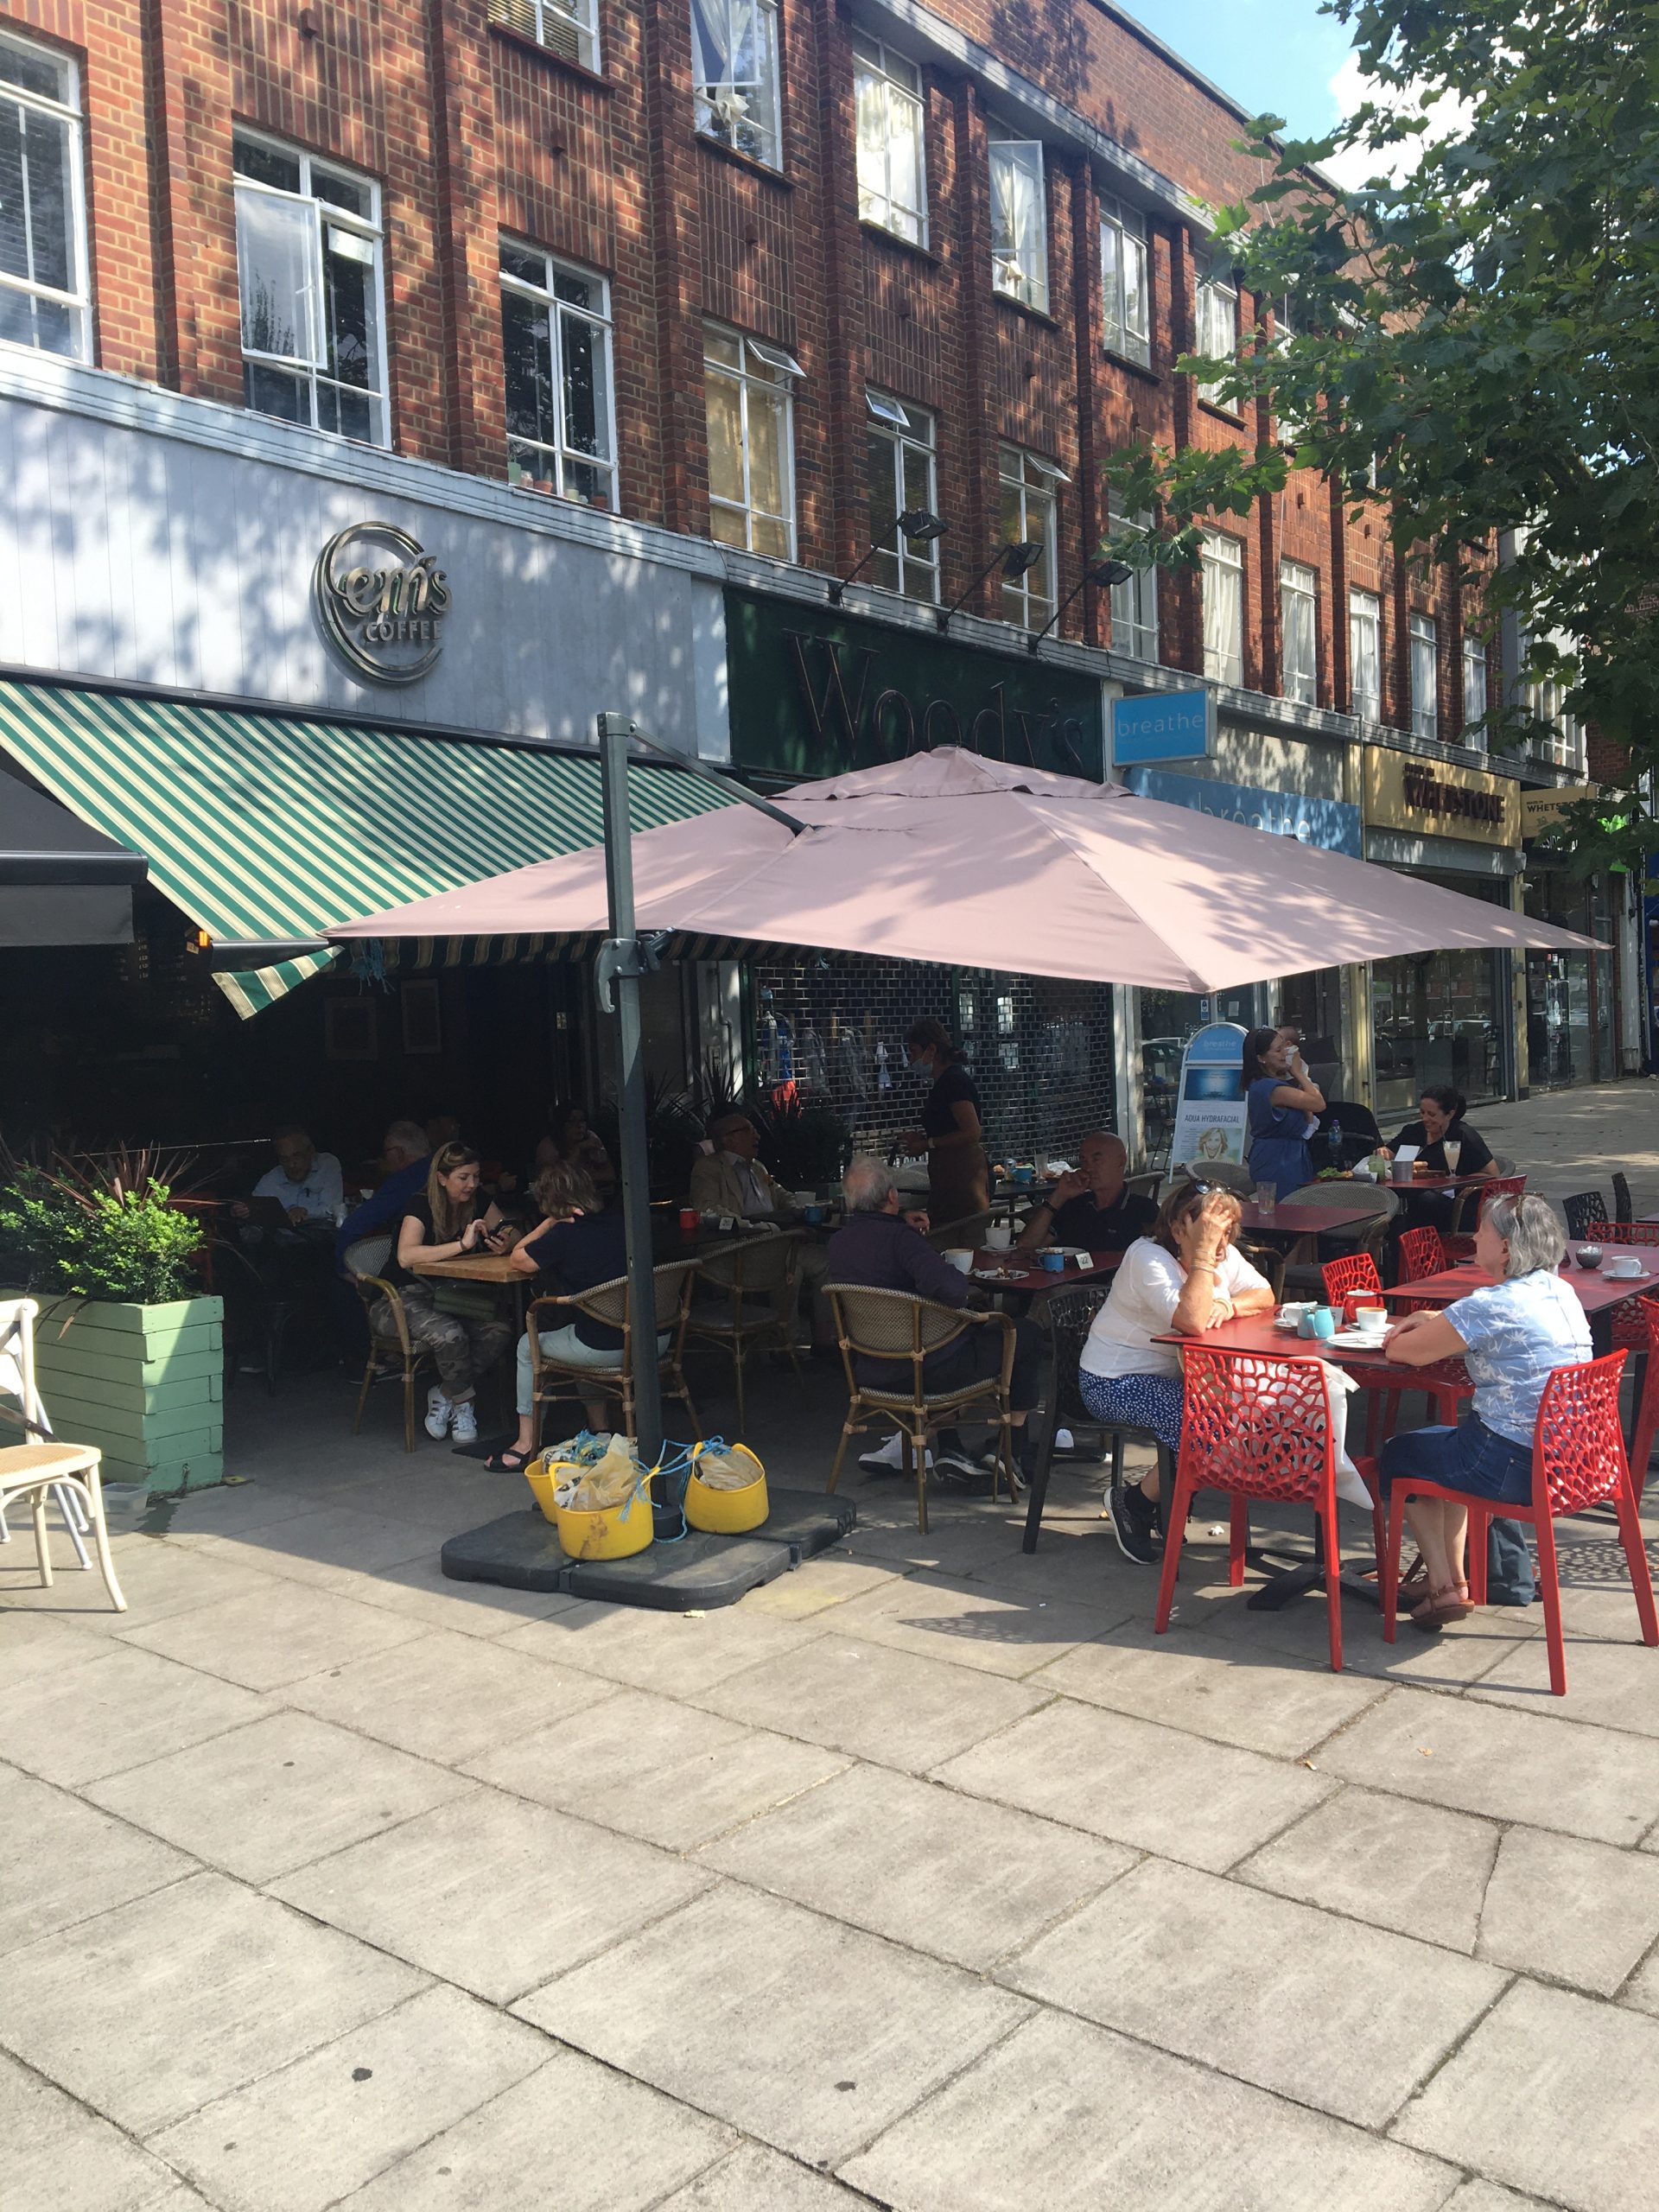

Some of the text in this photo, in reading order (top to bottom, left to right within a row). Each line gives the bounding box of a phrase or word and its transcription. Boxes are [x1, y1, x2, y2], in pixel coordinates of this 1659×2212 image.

[364, 619, 442, 642] COFFEE
[1117, 711, 1204, 736] breathe
[1184, 1114, 1240, 1123] AQUA HYDRAFACIAL
